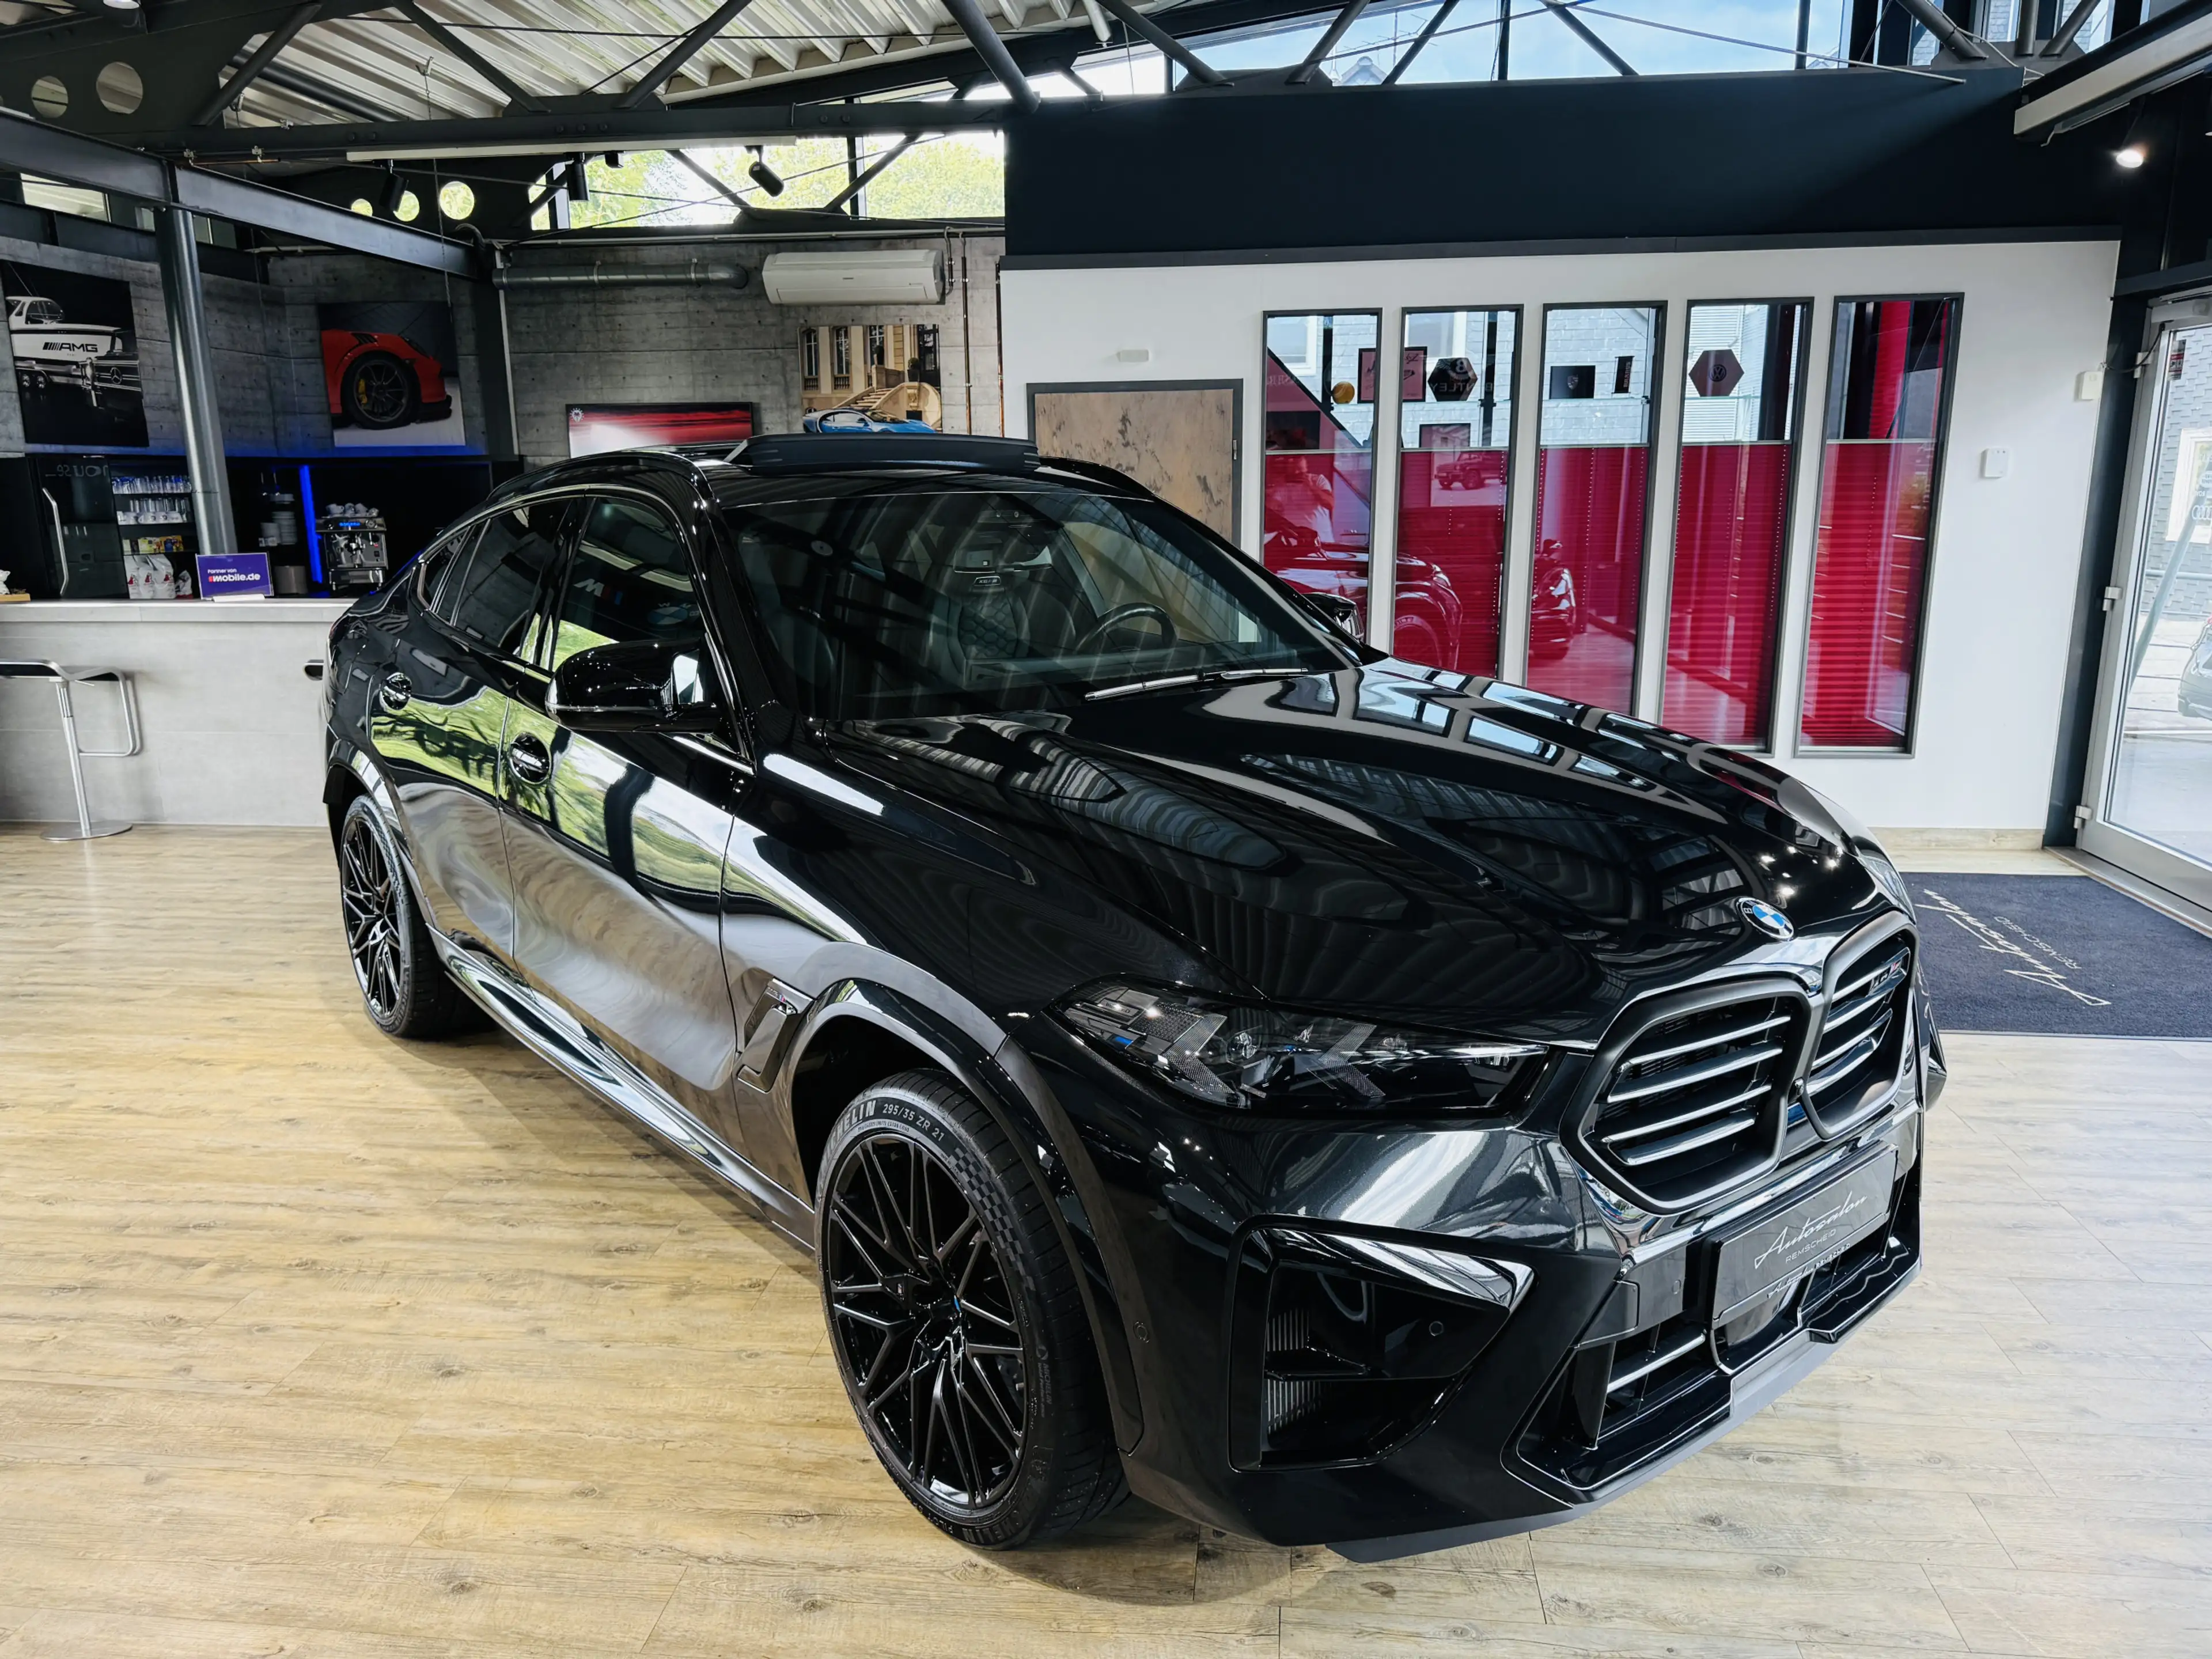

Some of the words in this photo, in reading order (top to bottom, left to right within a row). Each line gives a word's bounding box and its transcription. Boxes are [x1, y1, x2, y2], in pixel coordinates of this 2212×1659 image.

[58, 342, 99, 353] AMG
[213, 573, 261, 582] mobile.de
[882, 1103, 916, 1121] 295/35
[916, 1115, 931, 1131] ZR
[931, 1127, 945, 1142] 21
[1754, 1190, 1868, 1270] Autosalon
[1786, 1229, 1836, 1263] REMSCHEID
